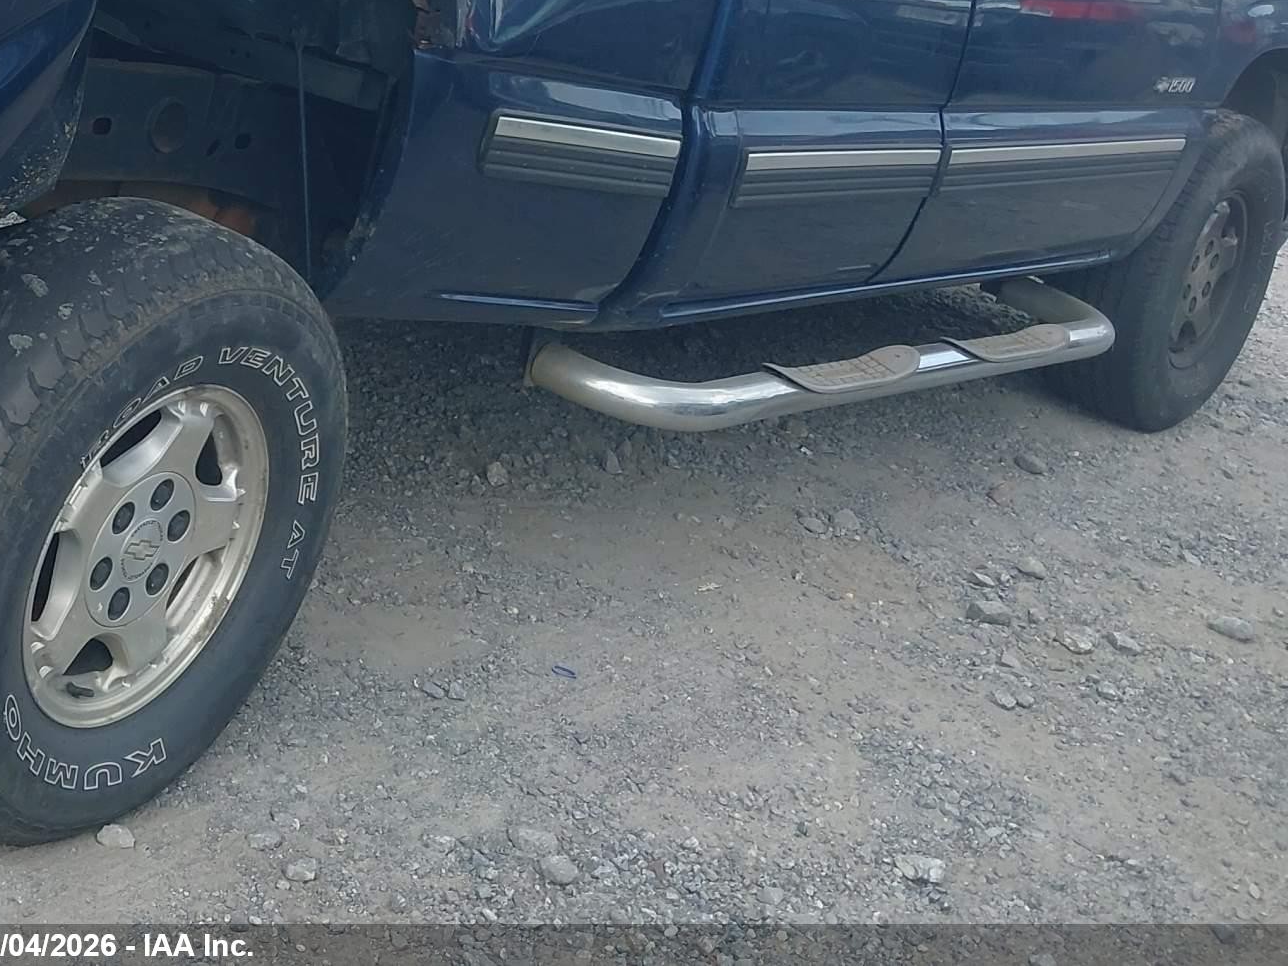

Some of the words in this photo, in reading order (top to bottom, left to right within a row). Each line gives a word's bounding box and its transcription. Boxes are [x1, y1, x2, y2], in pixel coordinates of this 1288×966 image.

[1167, 77, 1197, 94] 1500
[217, 344, 322, 507] VENTURE
[279, 518, 307, 581] AT
[3, 693, 167, 791] KUMHO
